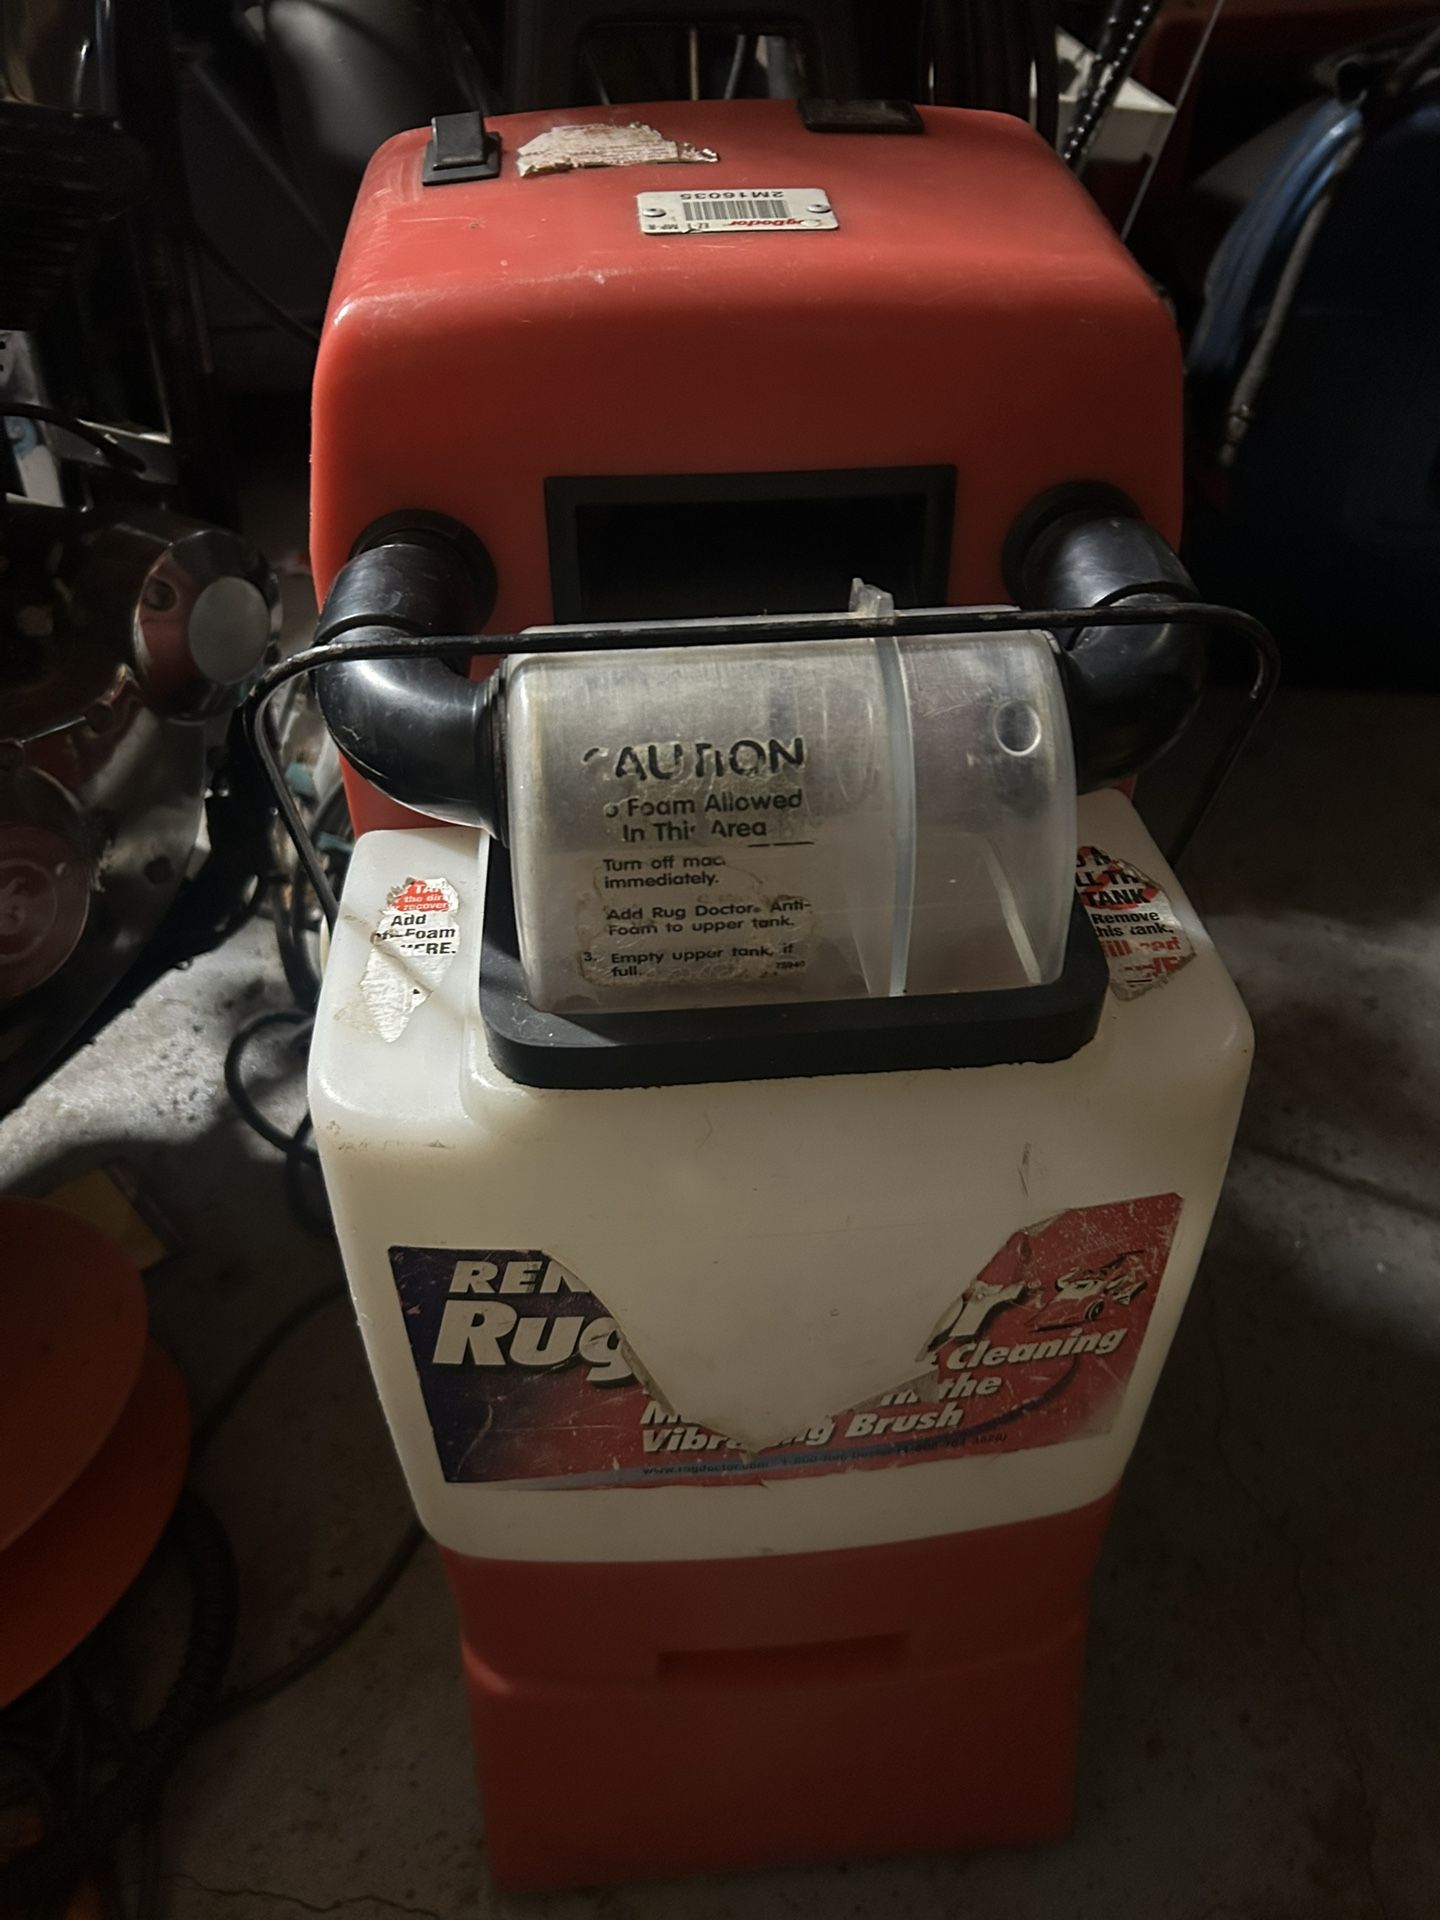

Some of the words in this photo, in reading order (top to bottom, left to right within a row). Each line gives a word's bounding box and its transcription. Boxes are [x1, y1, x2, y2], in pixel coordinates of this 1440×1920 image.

[627, 797, 696, 817] Foam
[704, 789, 802, 813] Allowed
[623, 824, 645, 843] In
[653, 820, 696, 842] Thi
[711, 820, 767, 838] Area
[603, 858, 642, 872] Turn
[651, 855, 675, 870] off
[604, 872, 720, 889] immediately.
[1082, 888, 1151, 906] TANK
[390, 913, 428, 927] Add
[606, 908, 643, 921] Add
[652, 906, 687, 922] Rug
[1091, 911, 1161, 925] Remove
[608, 924, 658, 937] Foam
[666, 922, 683, 933] to
[692, 919, 744, 934] upper
[611, 950, 664, 966] Empty
[672, 948, 722, 963] upper
[611, 965, 642, 978] full.
[432, 1299, 634, 1383] Rug
[946, 1327, 1128, 1371] Cleaning
[844, 1401, 965, 1439] Brush
